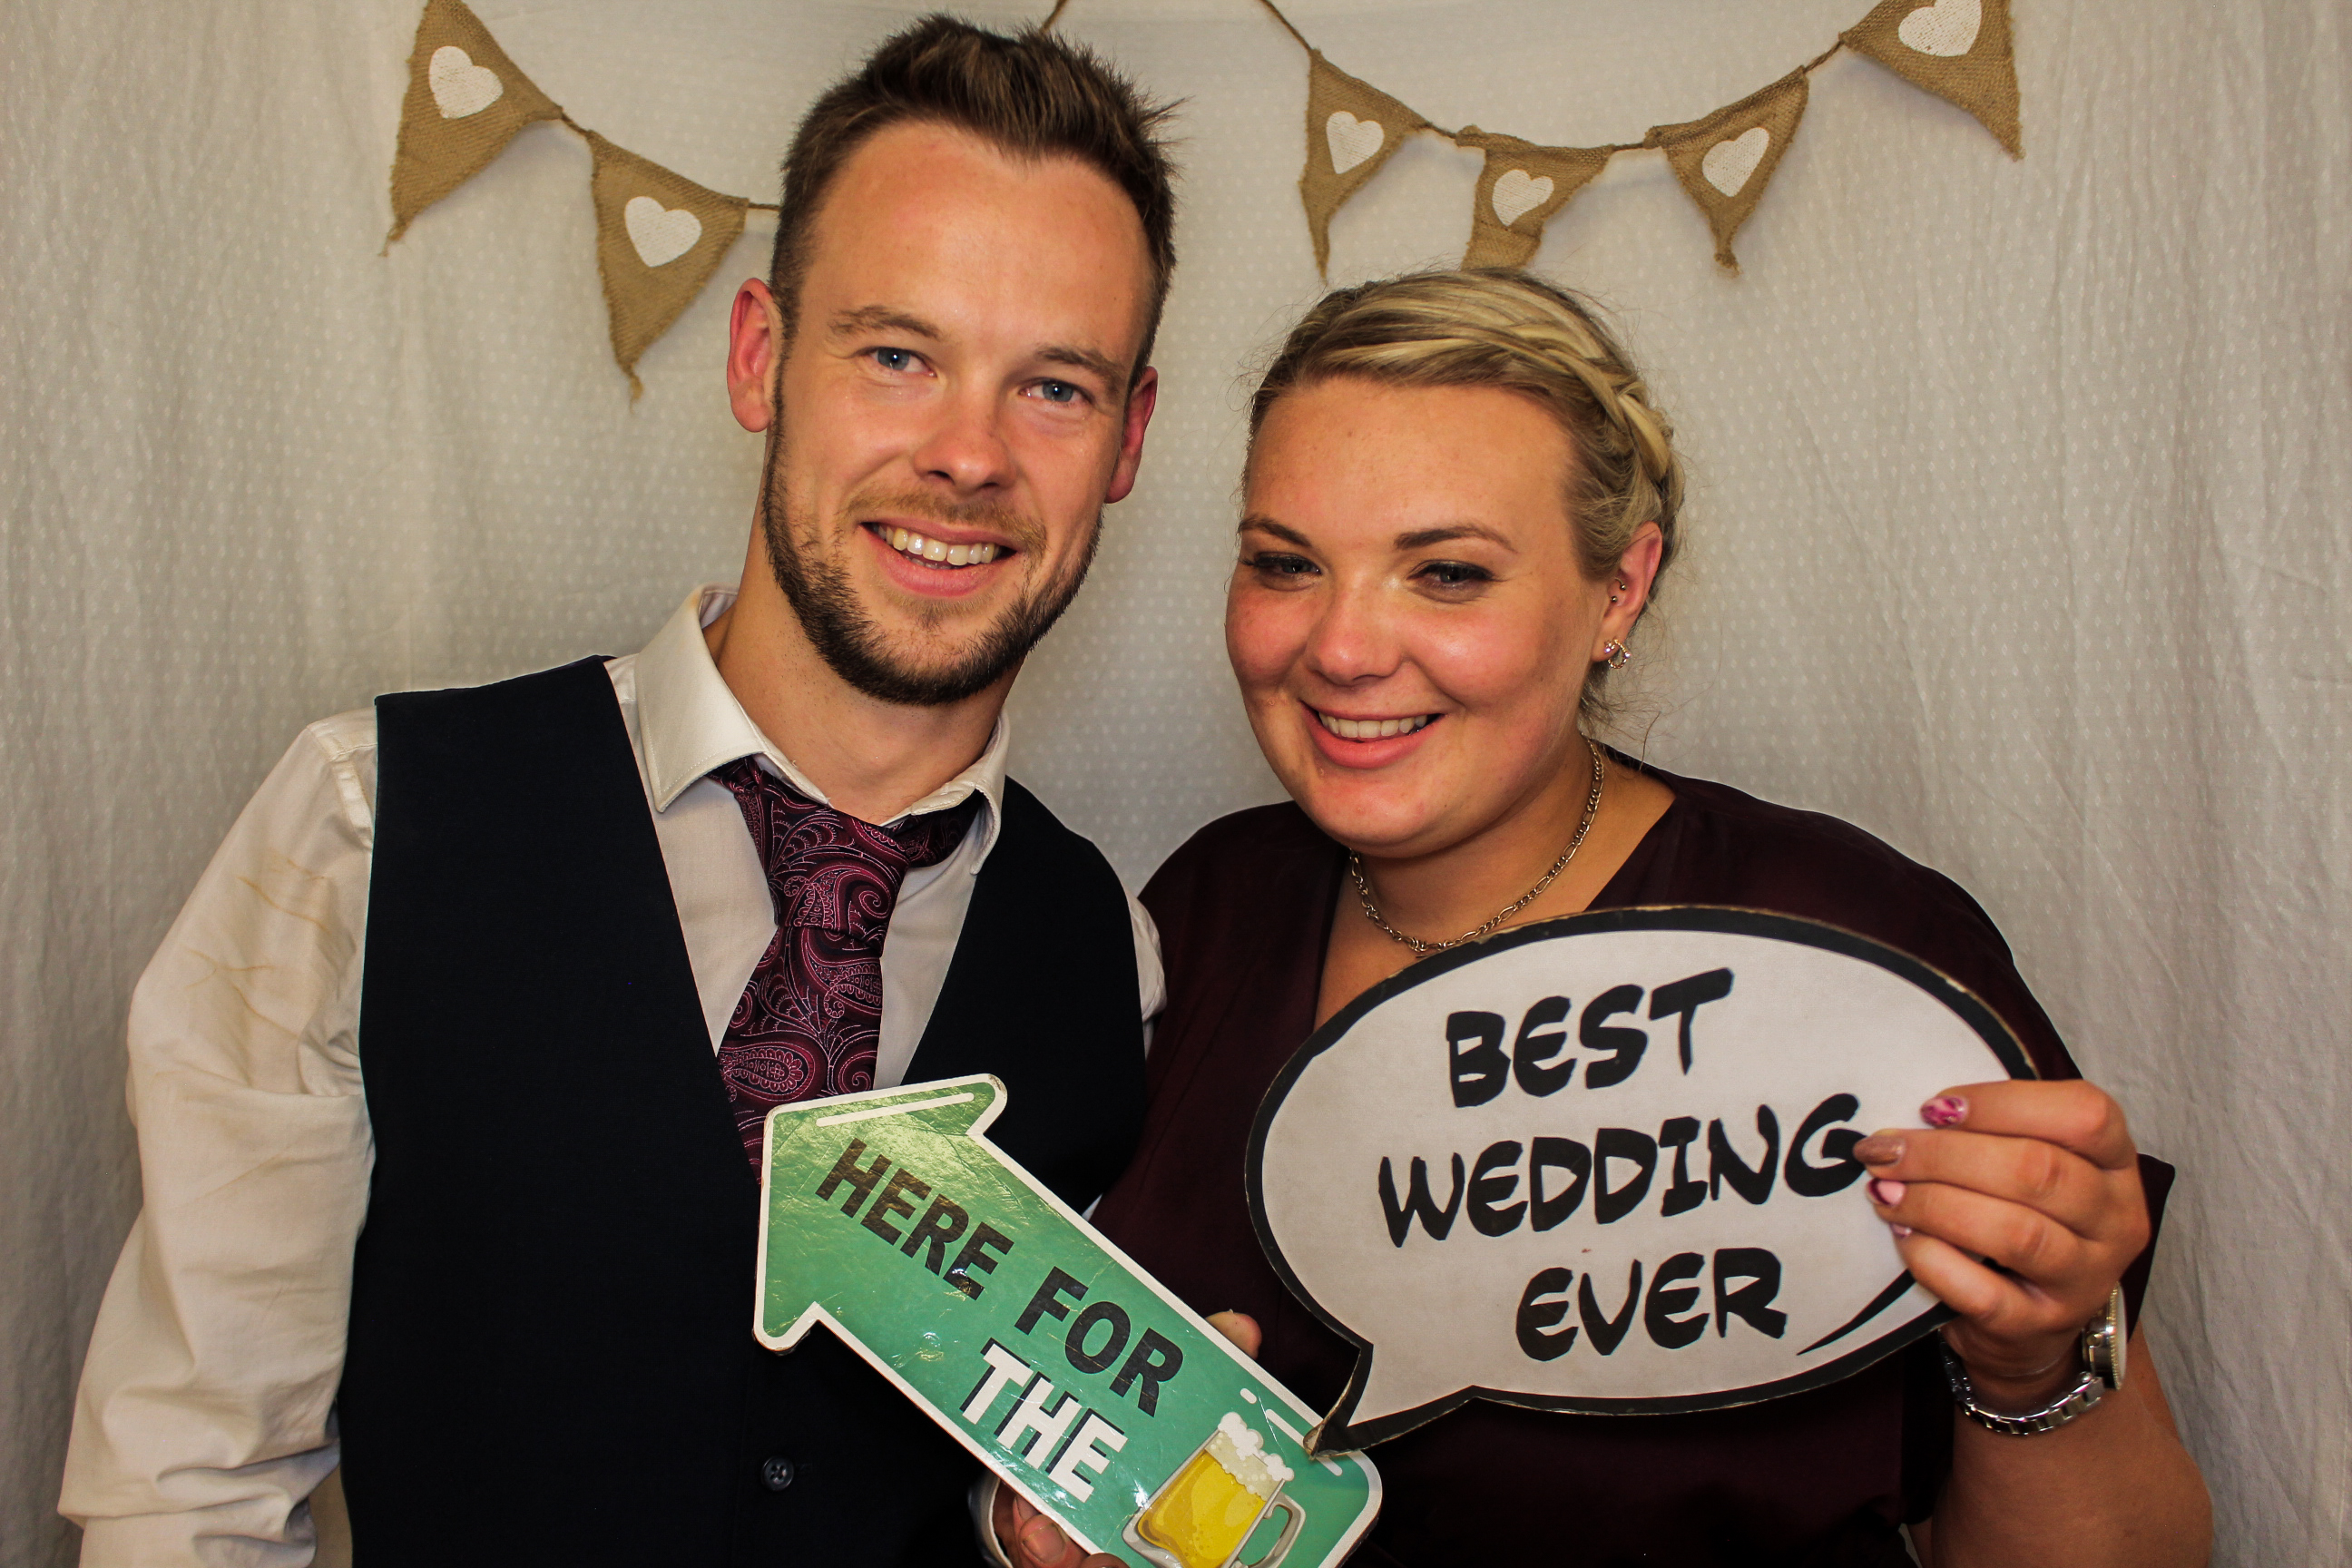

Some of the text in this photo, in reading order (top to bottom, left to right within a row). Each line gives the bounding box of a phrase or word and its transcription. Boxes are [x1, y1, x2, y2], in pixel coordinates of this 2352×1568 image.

[1446, 967, 1734, 1108] BEST
[1378, 1093, 1867, 1248] WEDDING
[816, 1138, 1184, 1417] HERE FOR
[1516, 1247, 1788, 1362] EVER
[959, 1338, 1128, 1503] THE
